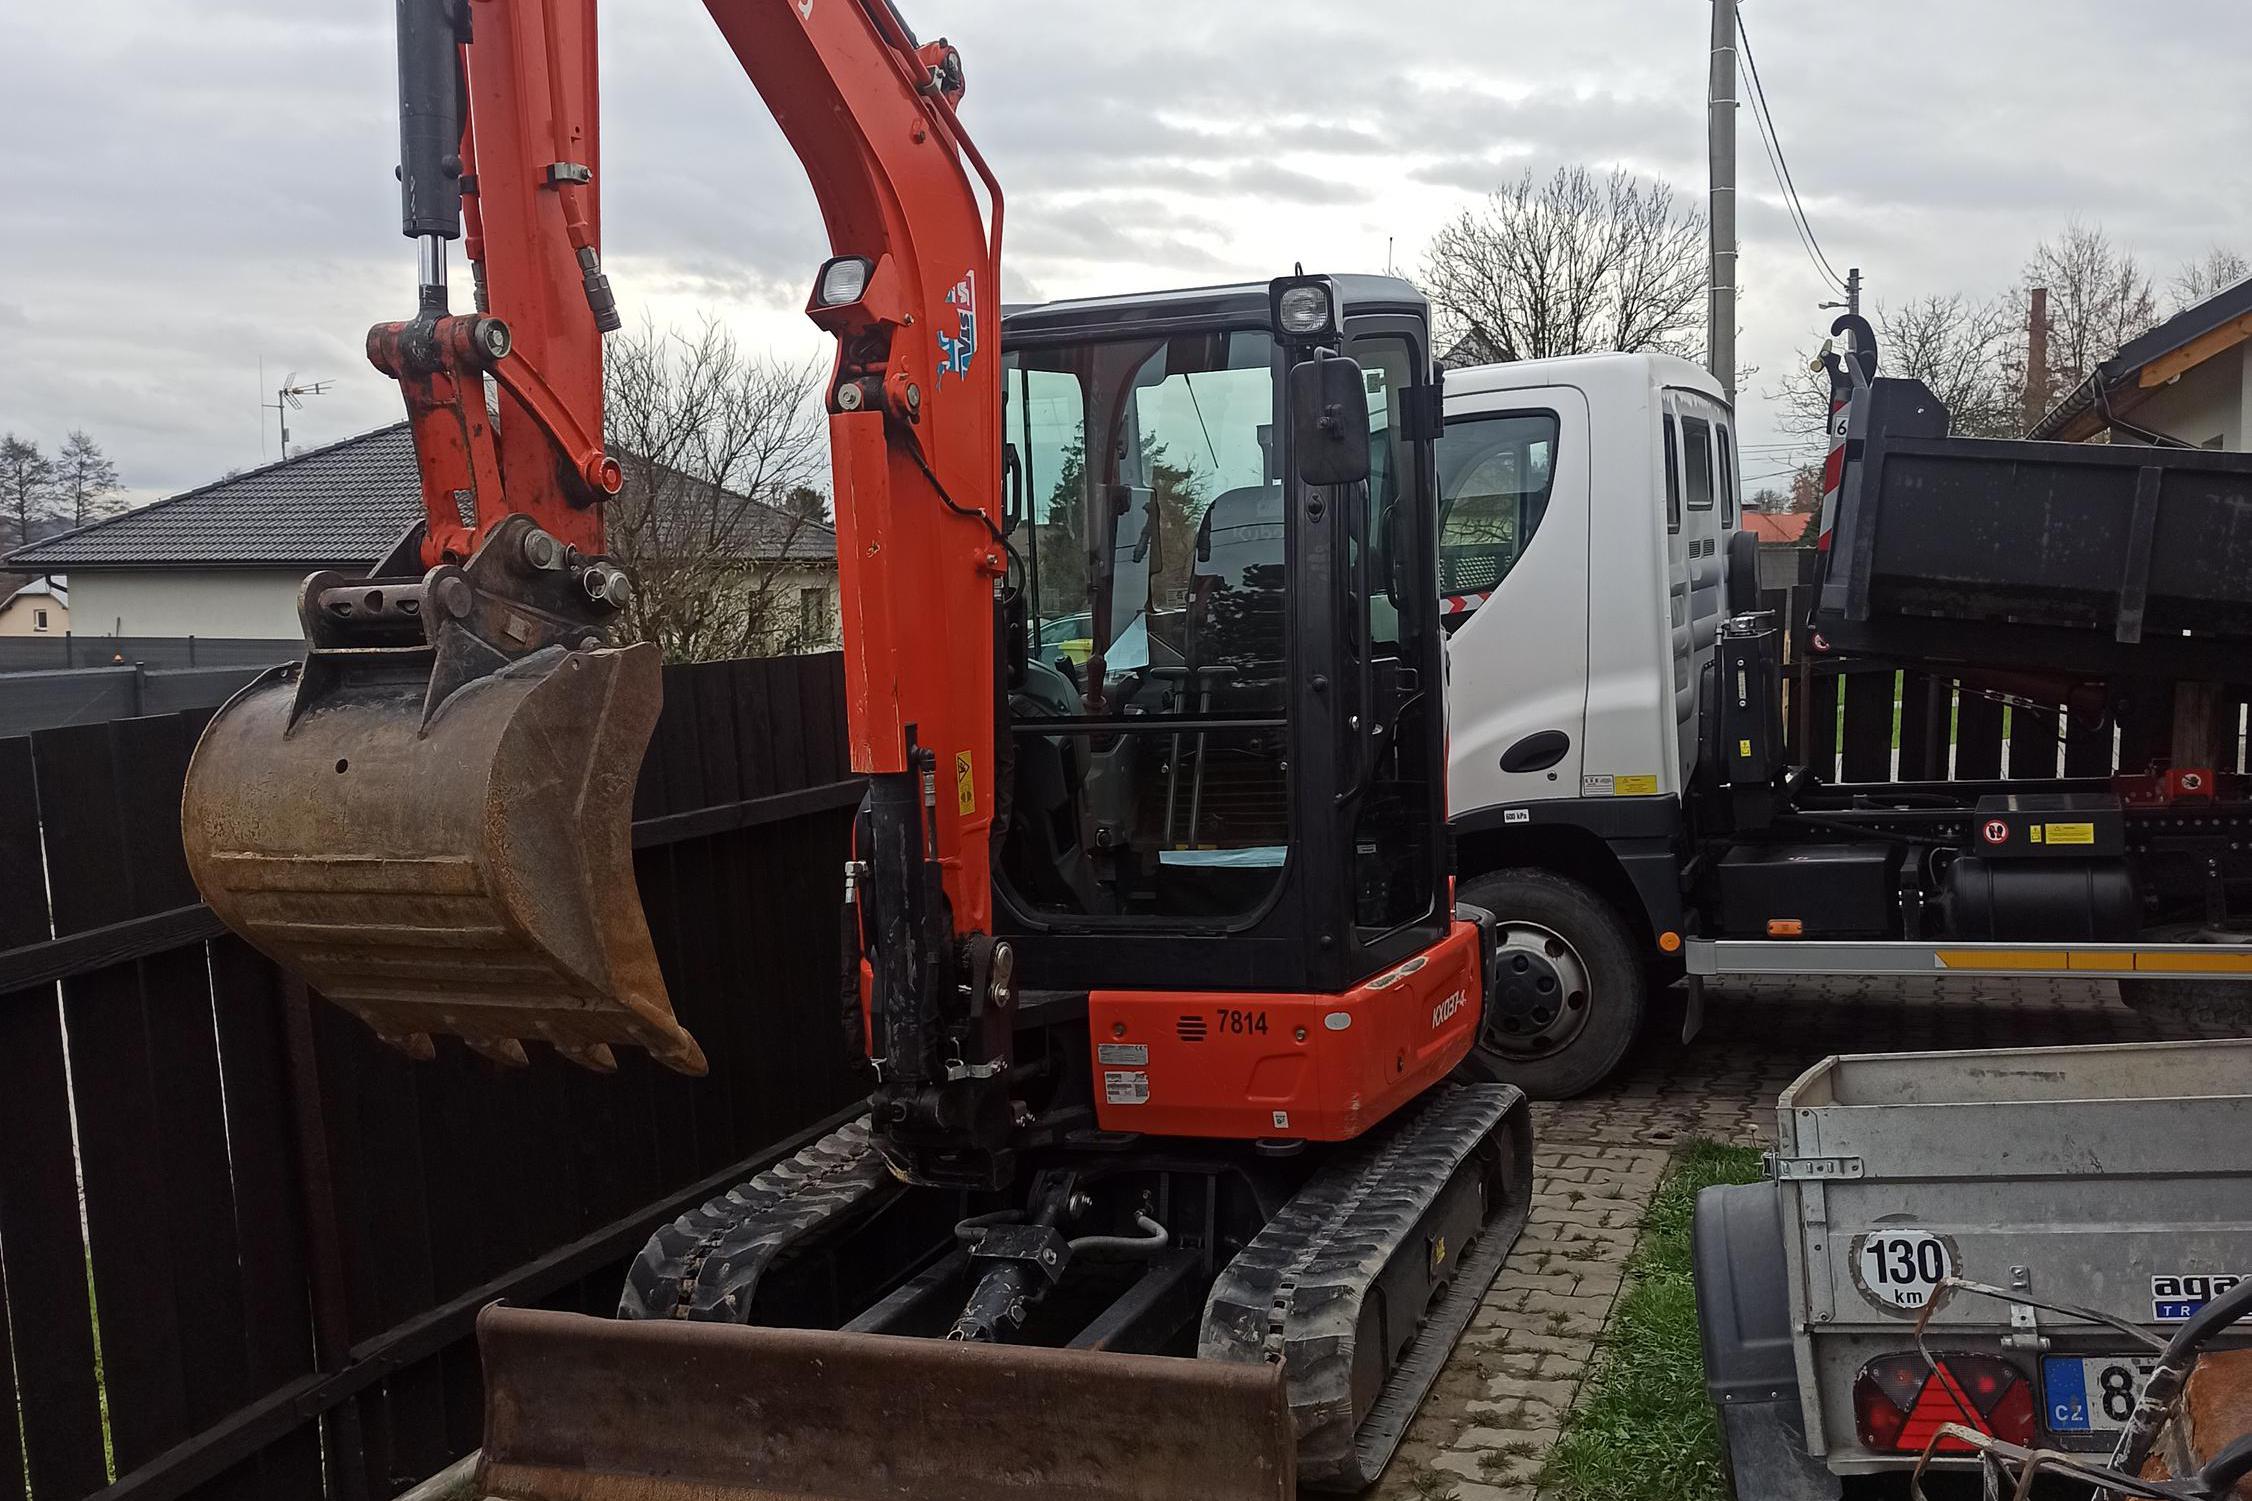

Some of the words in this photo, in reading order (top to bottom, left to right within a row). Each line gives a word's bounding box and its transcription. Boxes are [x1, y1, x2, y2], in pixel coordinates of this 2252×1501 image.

[1837, 419, 1847, 436] 6
[1216, 1008, 1269, 1035] 7814
[1866, 1239, 1944, 1284] 130
[1894, 1288, 1923, 1304] km
[2154, 1276, 2252, 1304] aga
[2054, 1404, 2084, 1421] CZ
[2100, 1365, 2156, 1421] 8
